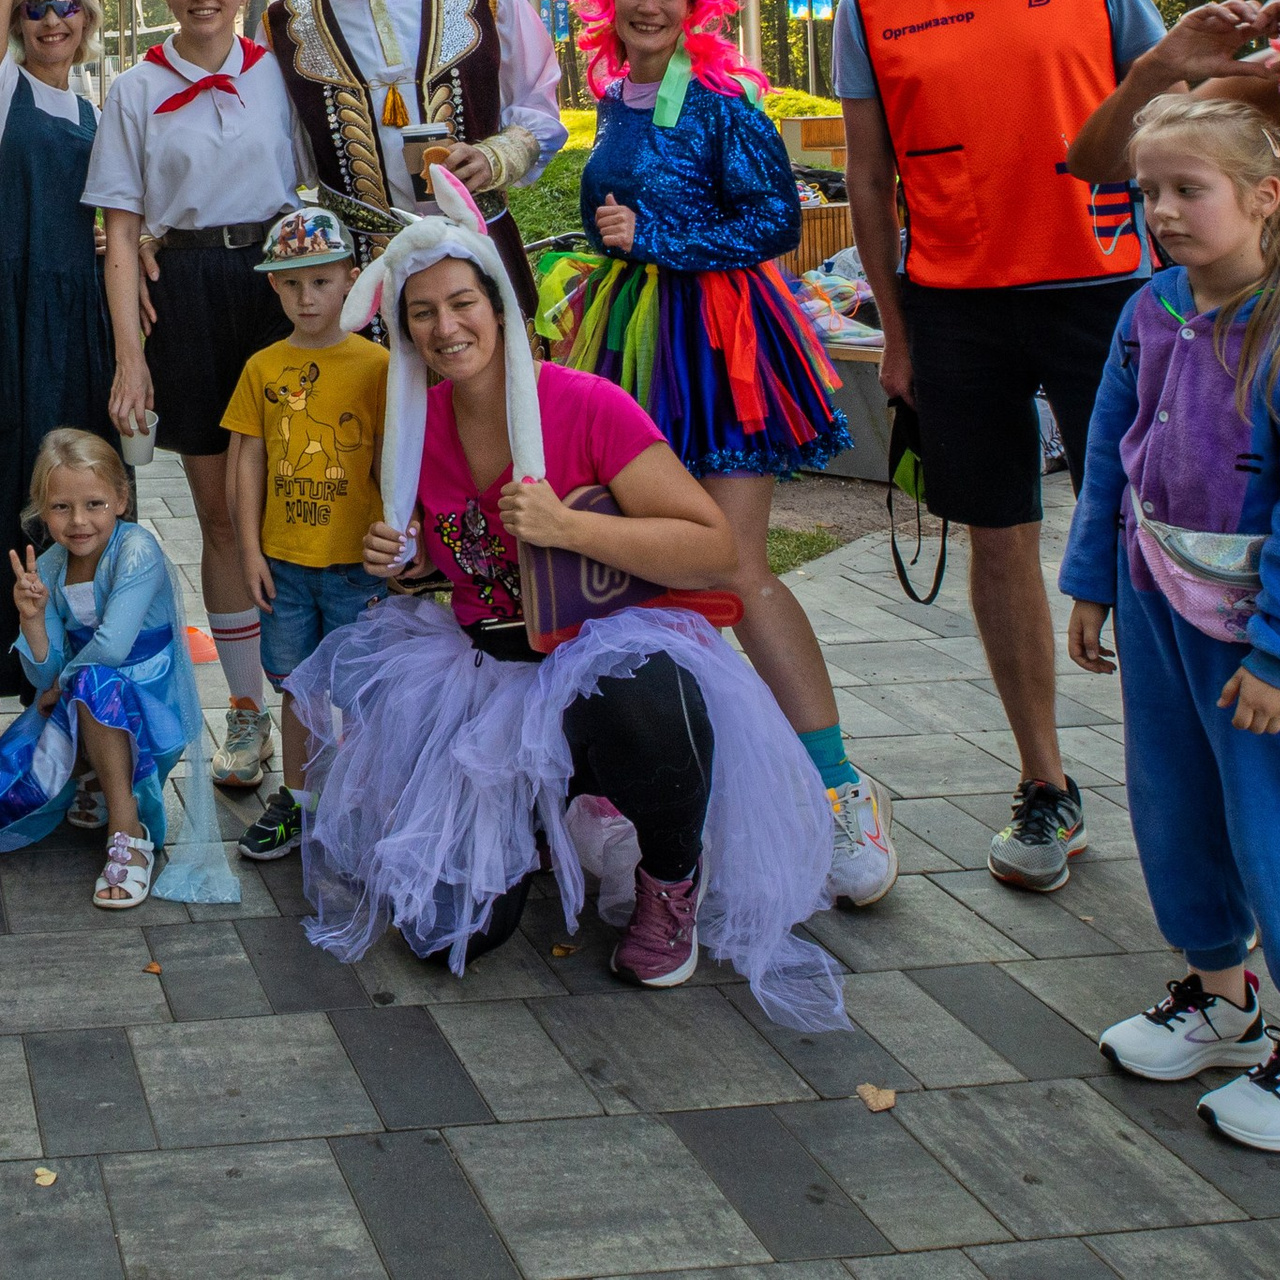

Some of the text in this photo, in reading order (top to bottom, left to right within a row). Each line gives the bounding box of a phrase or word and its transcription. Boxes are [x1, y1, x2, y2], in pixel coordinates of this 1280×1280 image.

[883, 12, 975, 40] Организатор
[275, 476, 348, 501] FUTURE
[286, 499, 331, 526] KING
